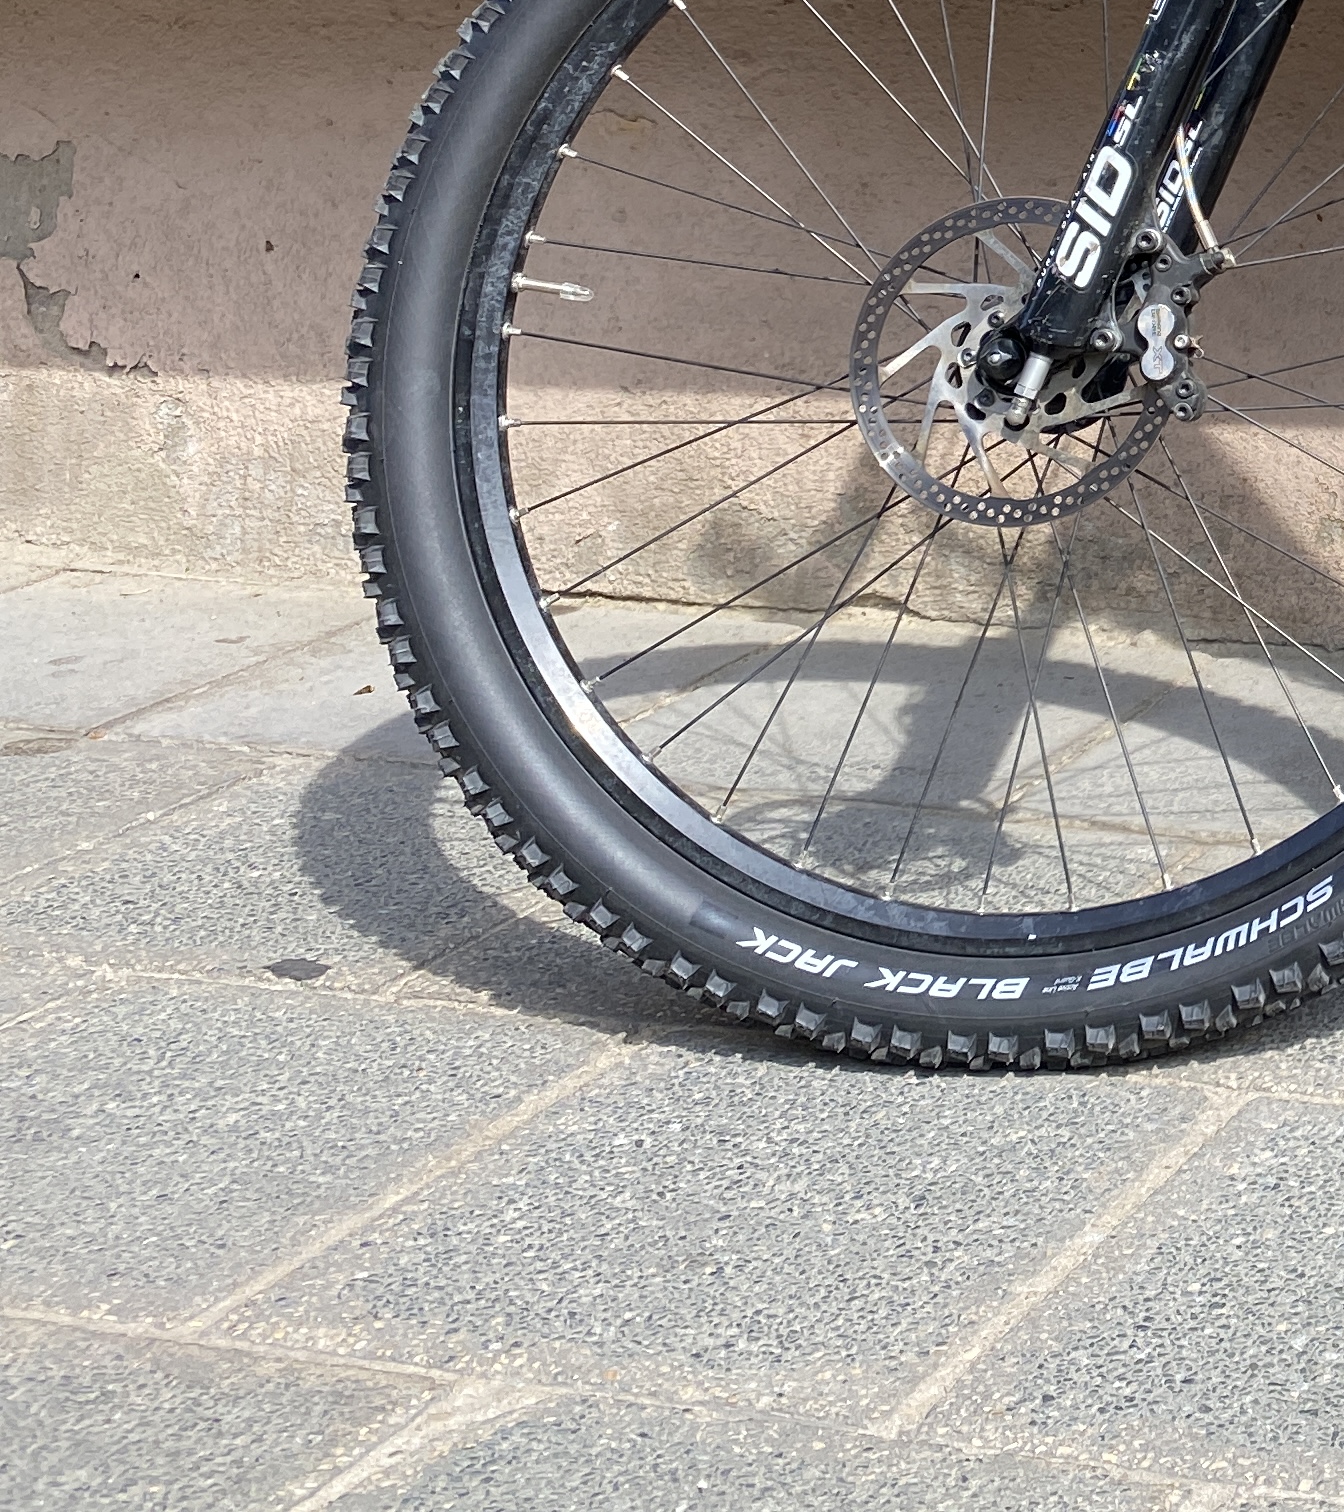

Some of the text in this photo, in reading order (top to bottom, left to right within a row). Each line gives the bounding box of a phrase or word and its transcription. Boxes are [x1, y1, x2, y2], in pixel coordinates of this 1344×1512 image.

[1055, 145, 1137, 288] SID
[1152, 346, 1164, 375] XT
[735, 926, 1031, 1001] BLACK JACK
[1087, 874, 1333, 992] SCHWALBE
